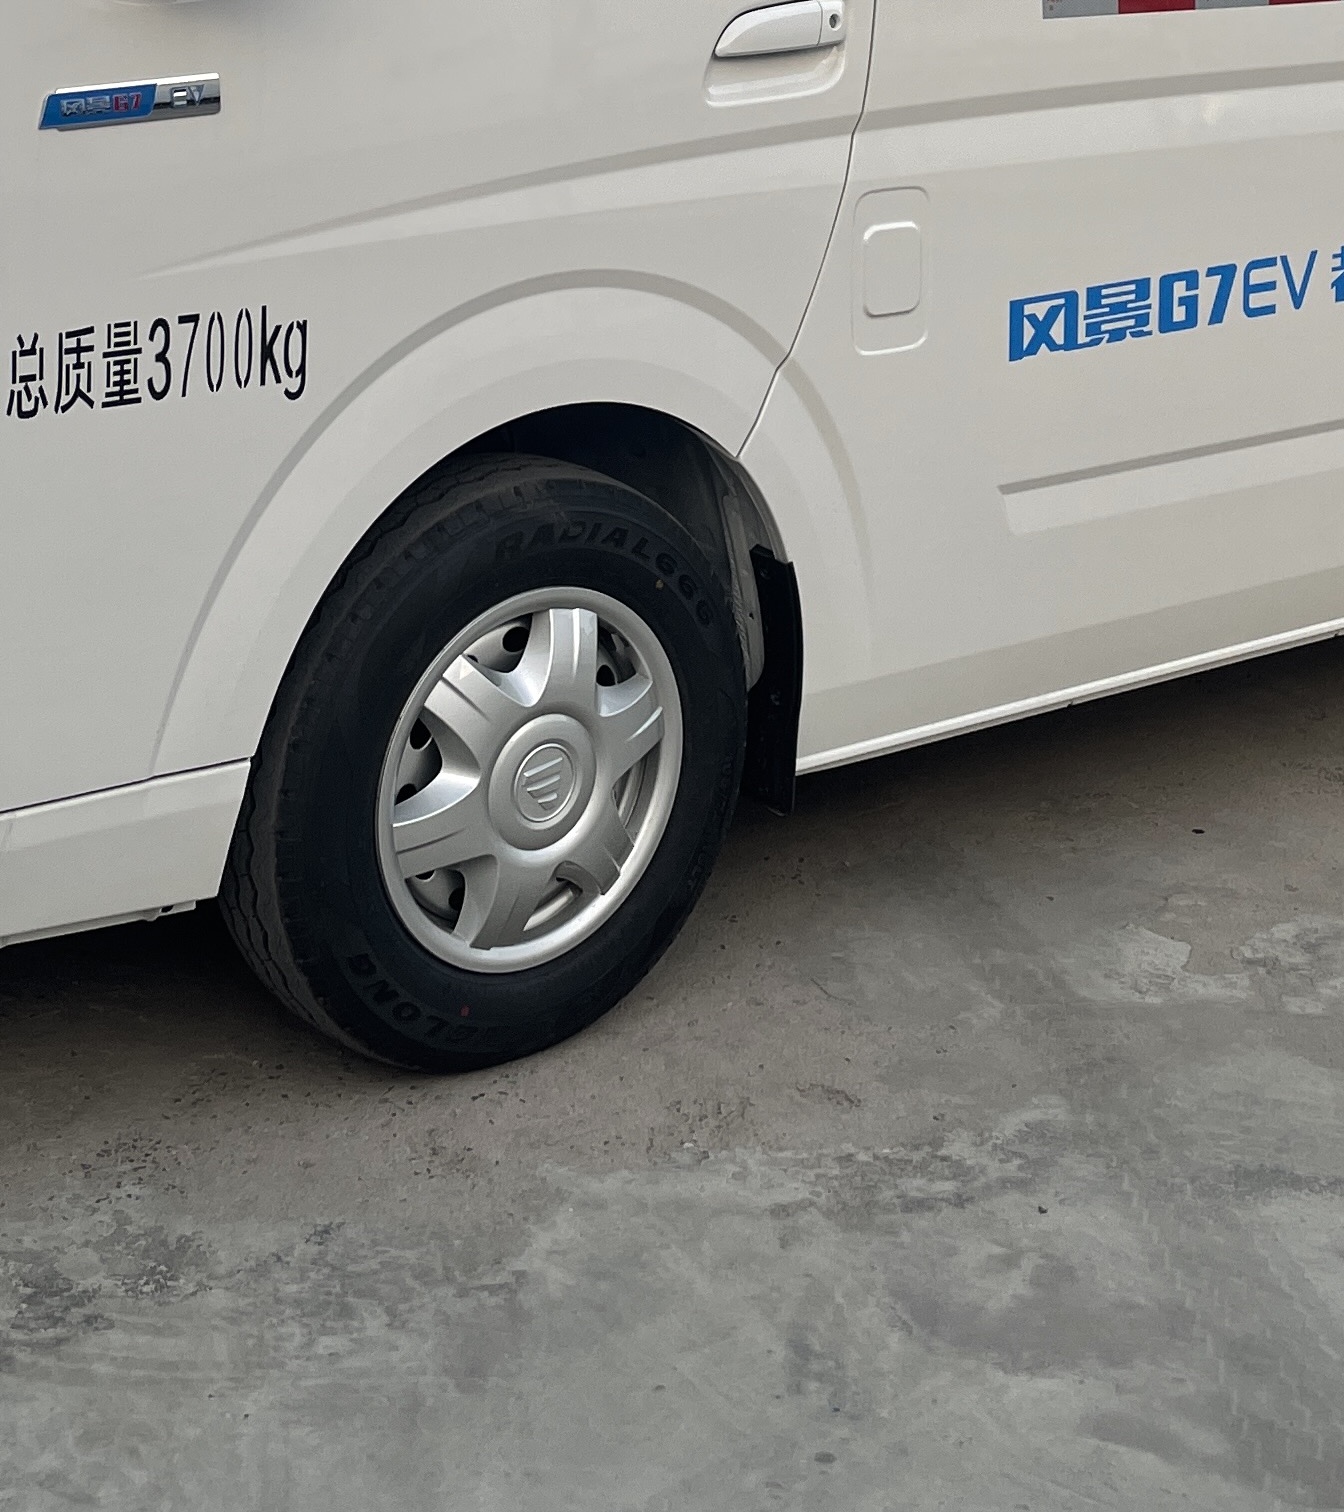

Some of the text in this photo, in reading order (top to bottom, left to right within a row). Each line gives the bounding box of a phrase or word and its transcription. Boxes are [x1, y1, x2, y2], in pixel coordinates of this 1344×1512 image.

[170, 84, 206, 108] EV
[1008, 249, 1318, 362] 风景G7EV
[6, 305, 308, 420] 总质量3700kg
